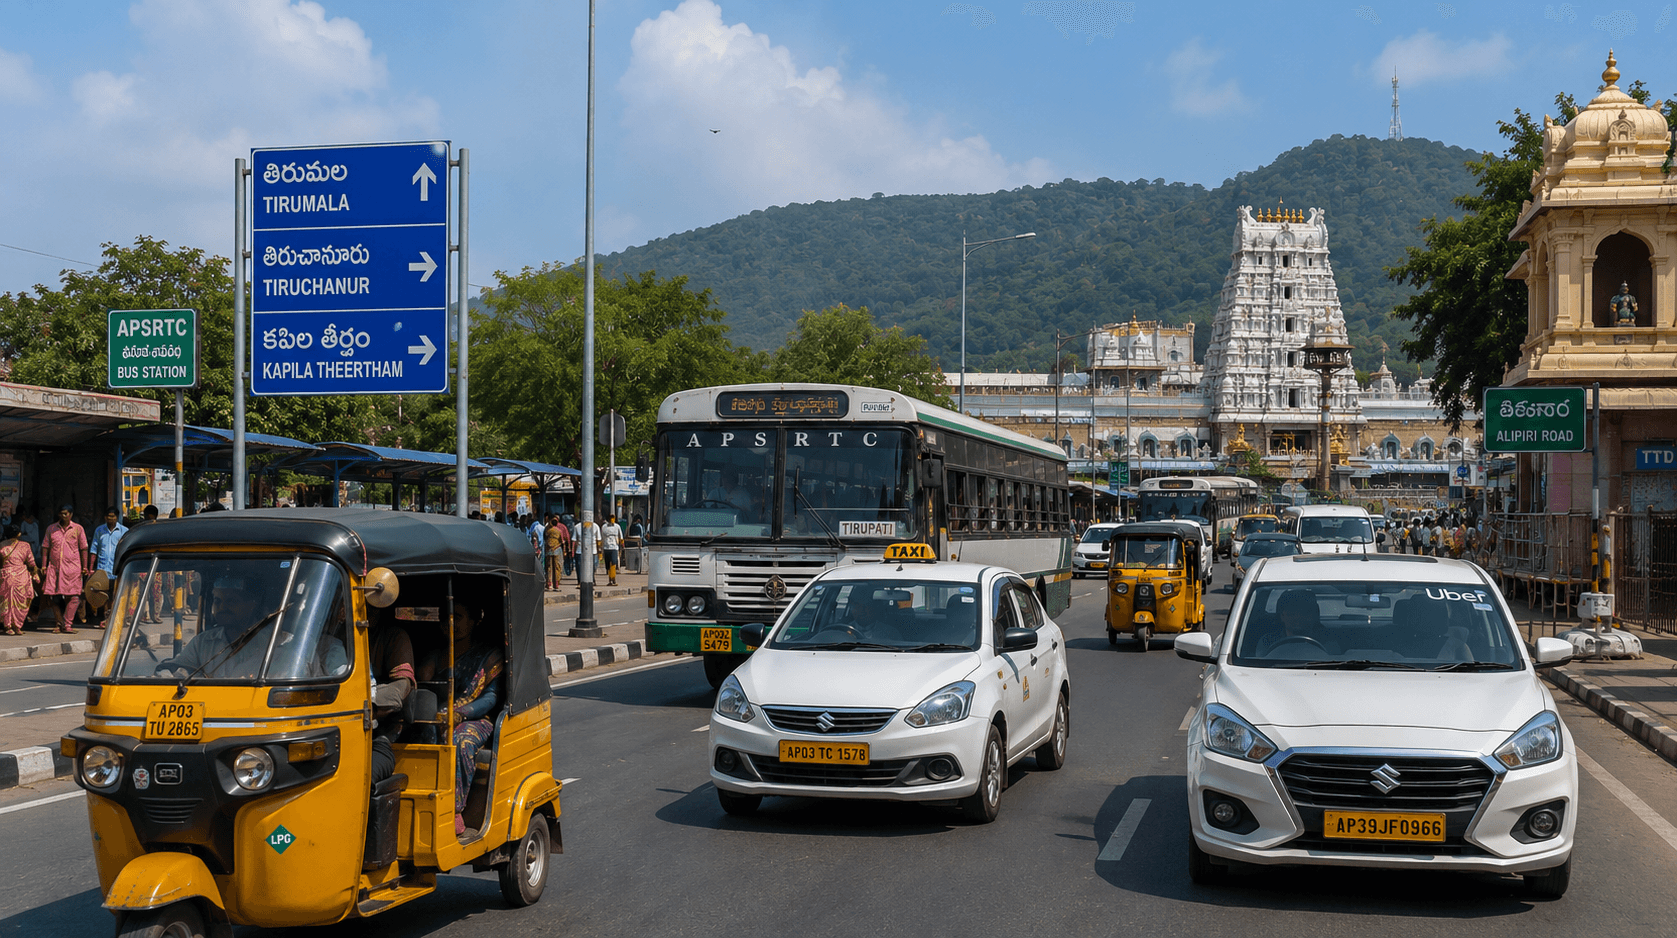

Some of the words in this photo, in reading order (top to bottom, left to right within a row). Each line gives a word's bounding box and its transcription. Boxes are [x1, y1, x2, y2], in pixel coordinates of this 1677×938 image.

[263, 160, 348, 184] తిరుమల
[263, 193, 350, 213] TIRUMALA
[263, 243, 370, 266] తిరుచానూరు
[263, 277, 370, 296] TIRUCHANUR
[117, 318, 187, 337] APSRTC
[263, 327, 313, 349] కపిల
[117, 366, 139, 379] BUS
[142, 365, 187, 378] STATION
[263, 362, 313, 379] KAPILA
[316, 360, 403, 378] THEERTHAM
[1496, 430, 1537, 441] ALIPIRI
[1541, 430, 1574, 441] ROAD
[1641, 450, 1674, 463] TTD
[842, 522, 893, 535] TIRUPATI
[890, 546, 925, 557] TAXI
[1425, 588, 1486, 603] Uber
[158, 704, 193, 718] AP03
[149, 721, 165, 735] TU
[167, 721, 199, 736] 2865
[787, 746, 815, 759] AP03
[818, 747, 833, 760] TC
[837, 747, 866, 761] 1578
[1336, 817, 1441, 836] AP39JF0966
[271, 833, 291, 844] LPG
